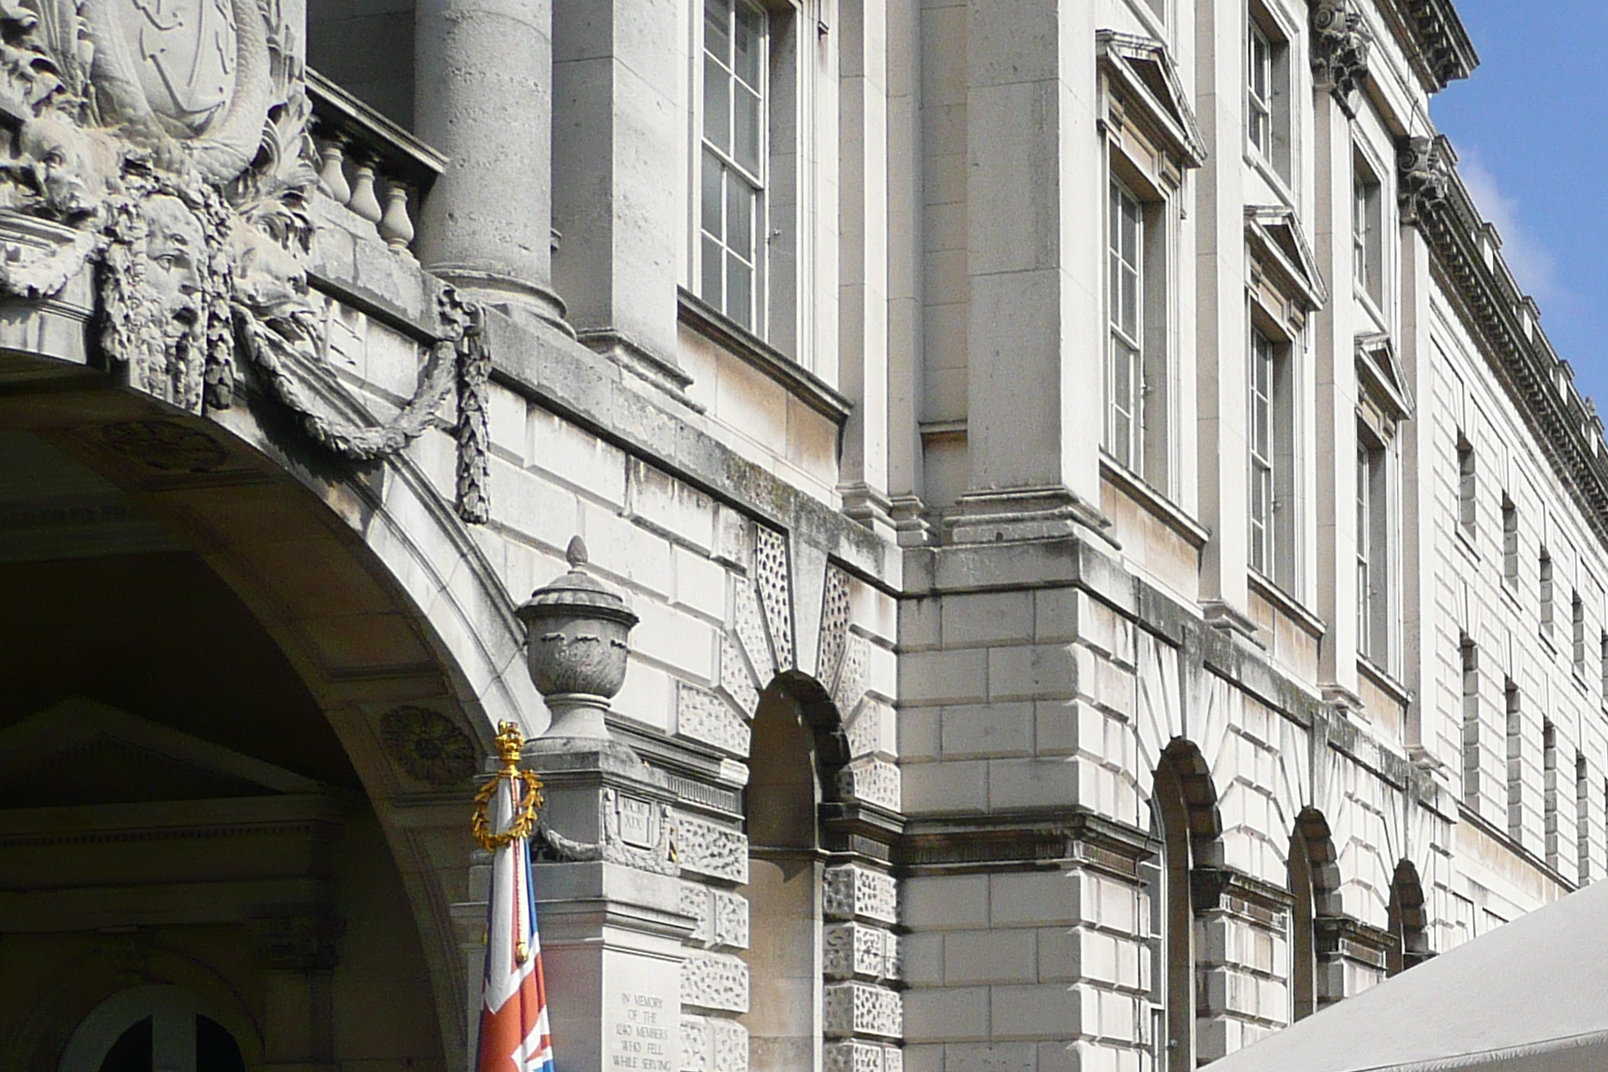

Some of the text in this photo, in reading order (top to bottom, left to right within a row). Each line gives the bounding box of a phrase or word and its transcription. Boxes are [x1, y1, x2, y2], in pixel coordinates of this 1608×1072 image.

[625, 814, 642, 830] XIX
[628, 1009, 657, 1023] OF THE
[621, 1040, 663, 1055] WHO FELL
[613, 1055, 671, 1071] WHILE SERVING
